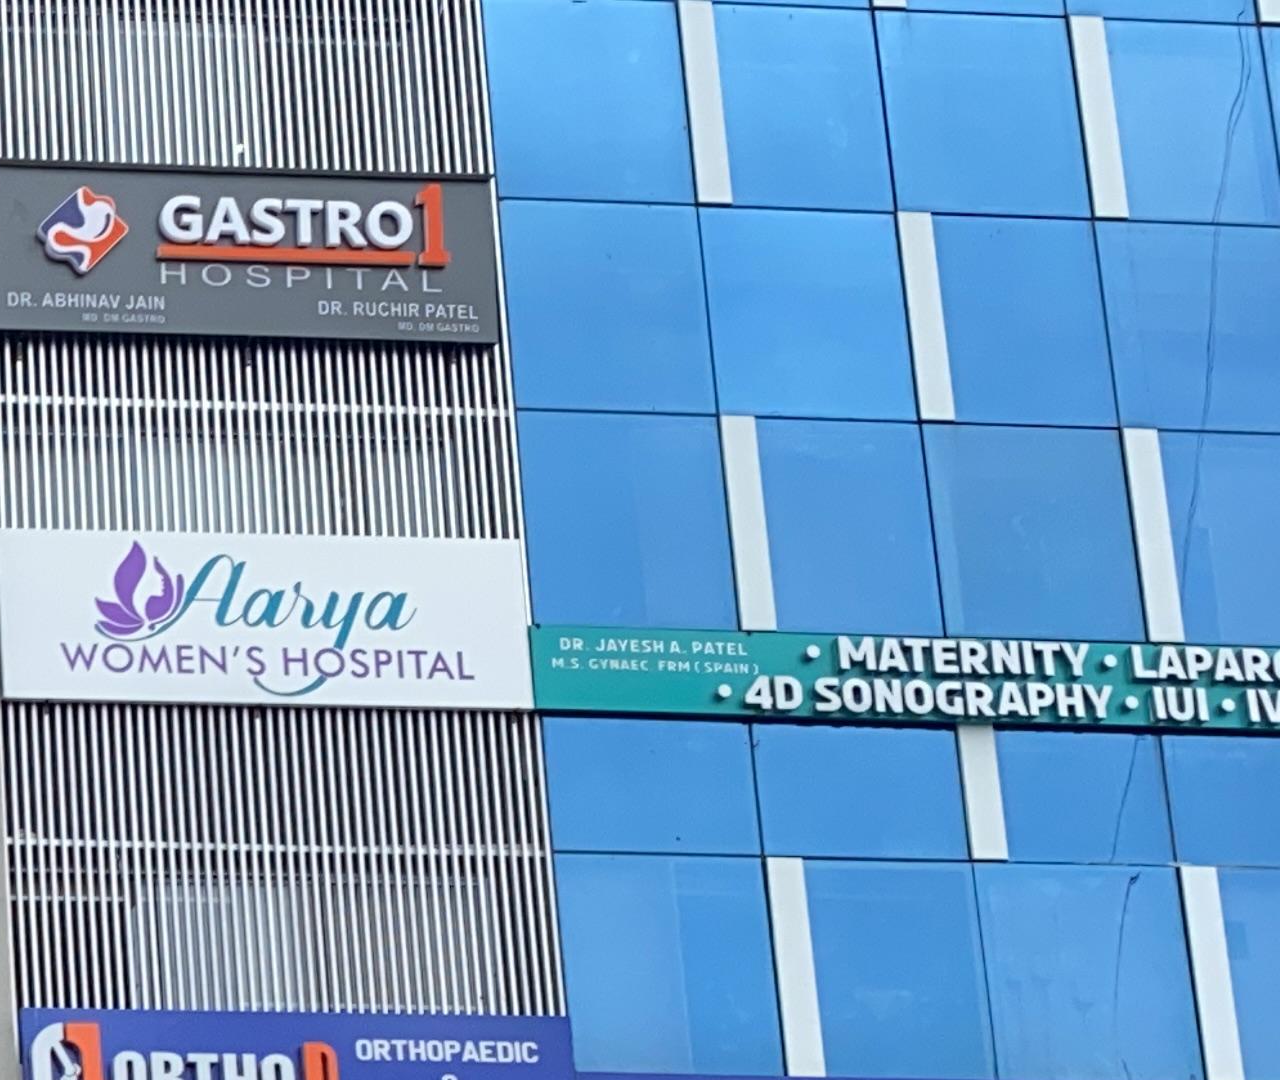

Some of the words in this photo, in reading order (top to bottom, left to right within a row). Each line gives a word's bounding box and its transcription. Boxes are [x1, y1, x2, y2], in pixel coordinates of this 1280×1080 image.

[159, 263, 444, 294] HOSPITAL
[7, 291, 38, 308] DR.
[42, 292, 121, 309] ABHINAV
[125, 295, 166, 311] JAIN
[317, 300, 348, 316] DR.
[353, 301, 420, 318] RUCHIR
[425, 303, 479, 320] PATEL
[121, 313, 166, 324] GASTRO
[436, 323, 480, 333] GASTRO
[155, 553, 418, 650] Aarya
[595, 638, 664, 654] JAYESH
[692, 641, 748, 656] PATEL
[837, 635, 1090, 677] MATERNITY
[60, 642, 265, 677] WOMEN'S
[283, 646, 476, 681] HOSPITAL
[658, 660, 690, 672] FRM
[744, 675, 803, 711] 4D
[814, 676, 1113, 720] SONOGRAPHY
[1151, 686, 1210, 721] IUI
[355, 1038, 539, 1064] ORTHOPAEDIC
